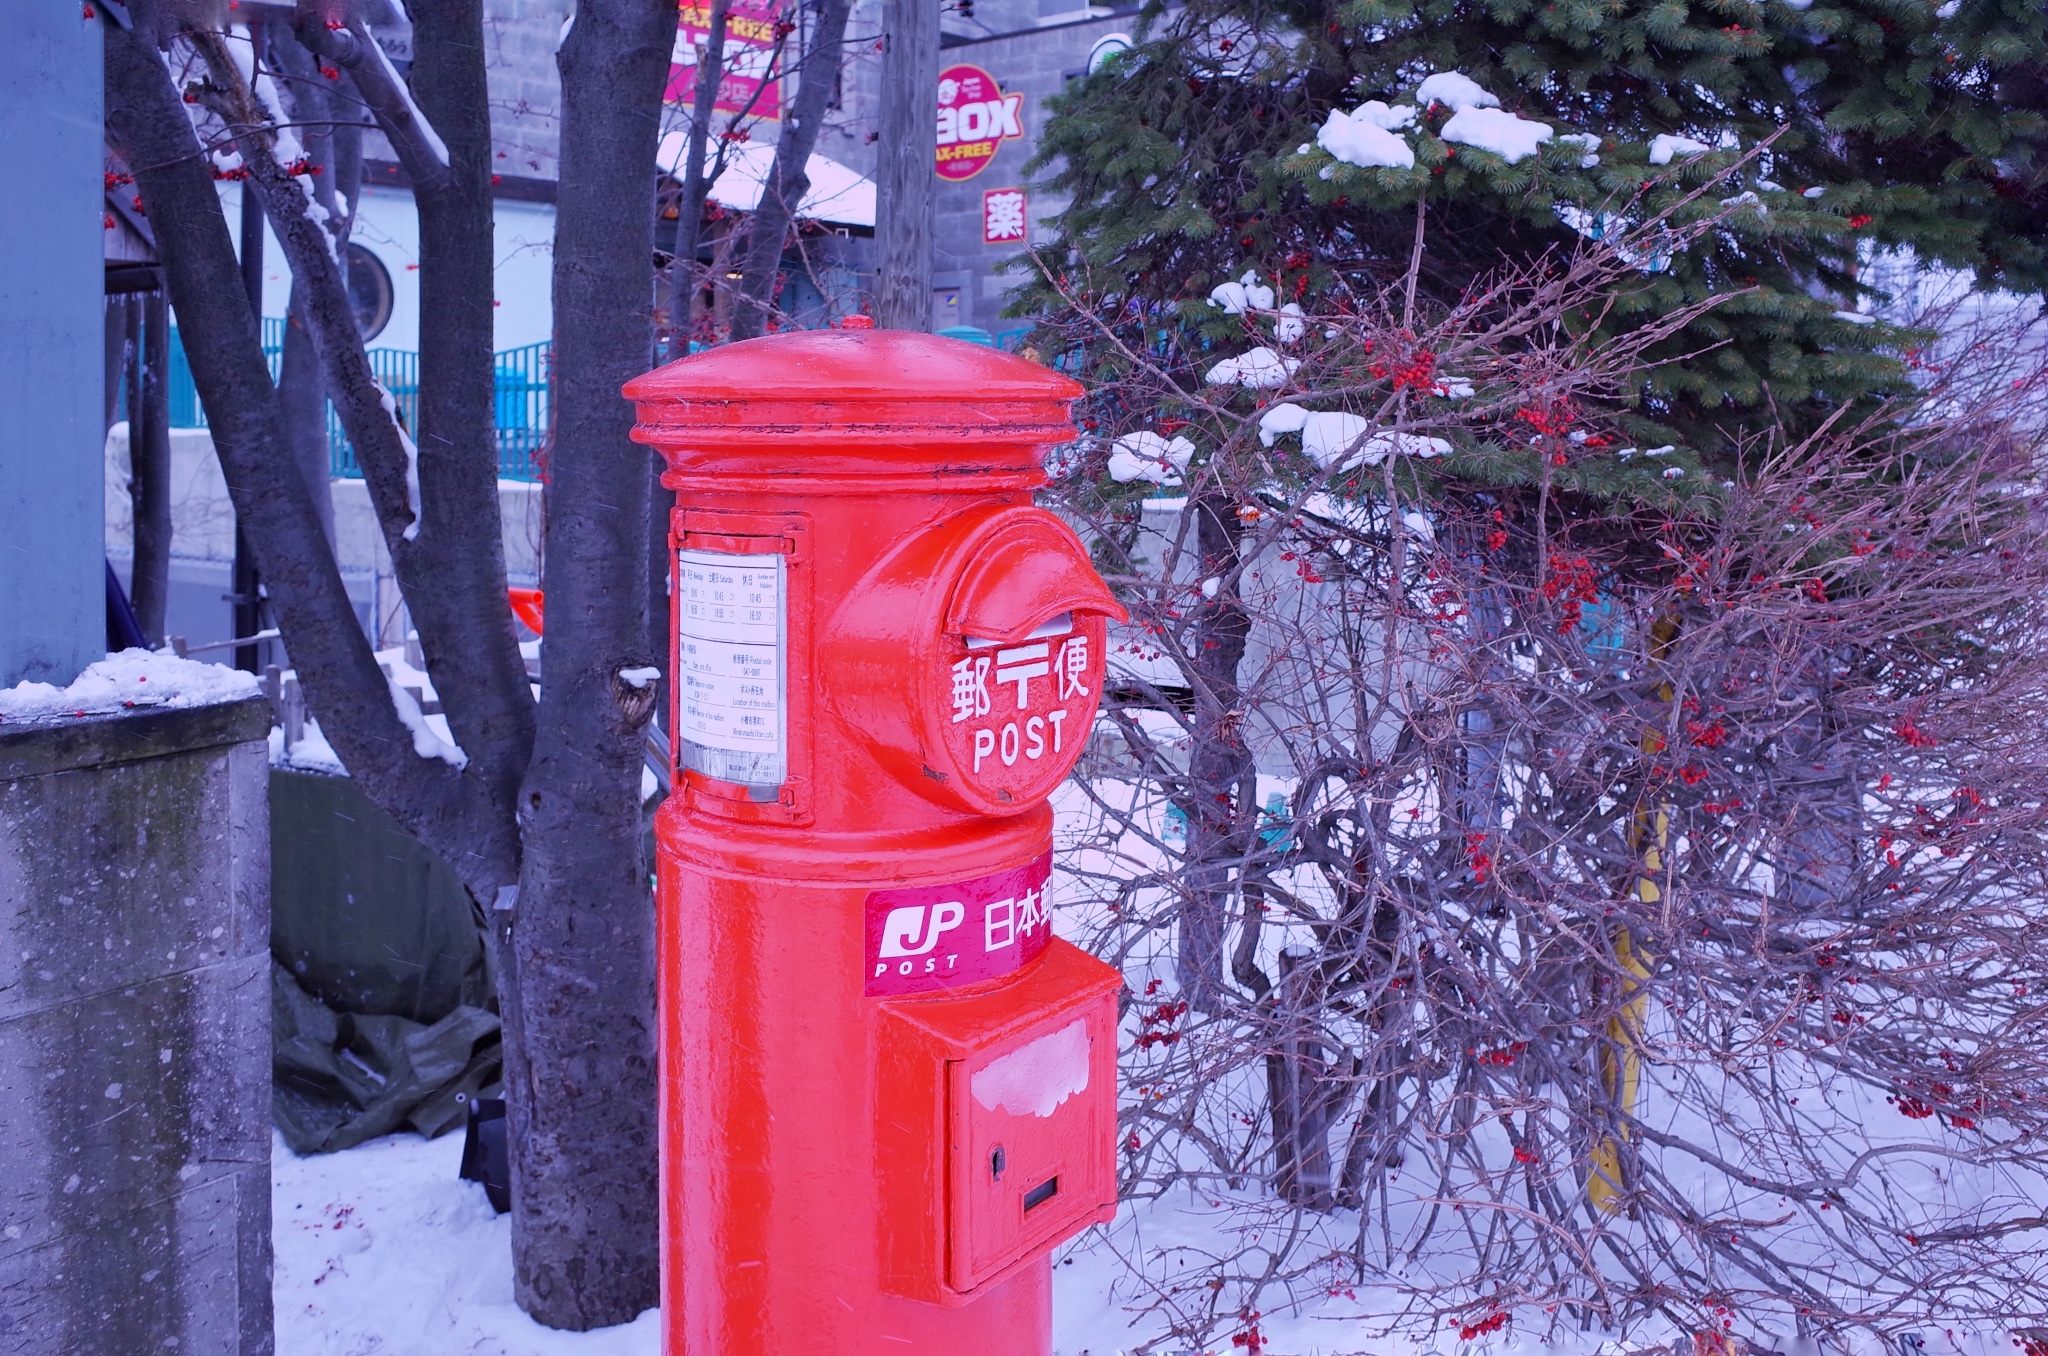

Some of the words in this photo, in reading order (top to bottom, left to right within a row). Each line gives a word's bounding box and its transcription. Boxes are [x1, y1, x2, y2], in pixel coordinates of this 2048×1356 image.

[936, 97, 1020, 145] AOX
[936, 142, 992, 161] AX-FREE
[987, 191, 1024, 239] 薬
[973, 709, 1068, 774] POST
[874, 953, 959, 978] POST
